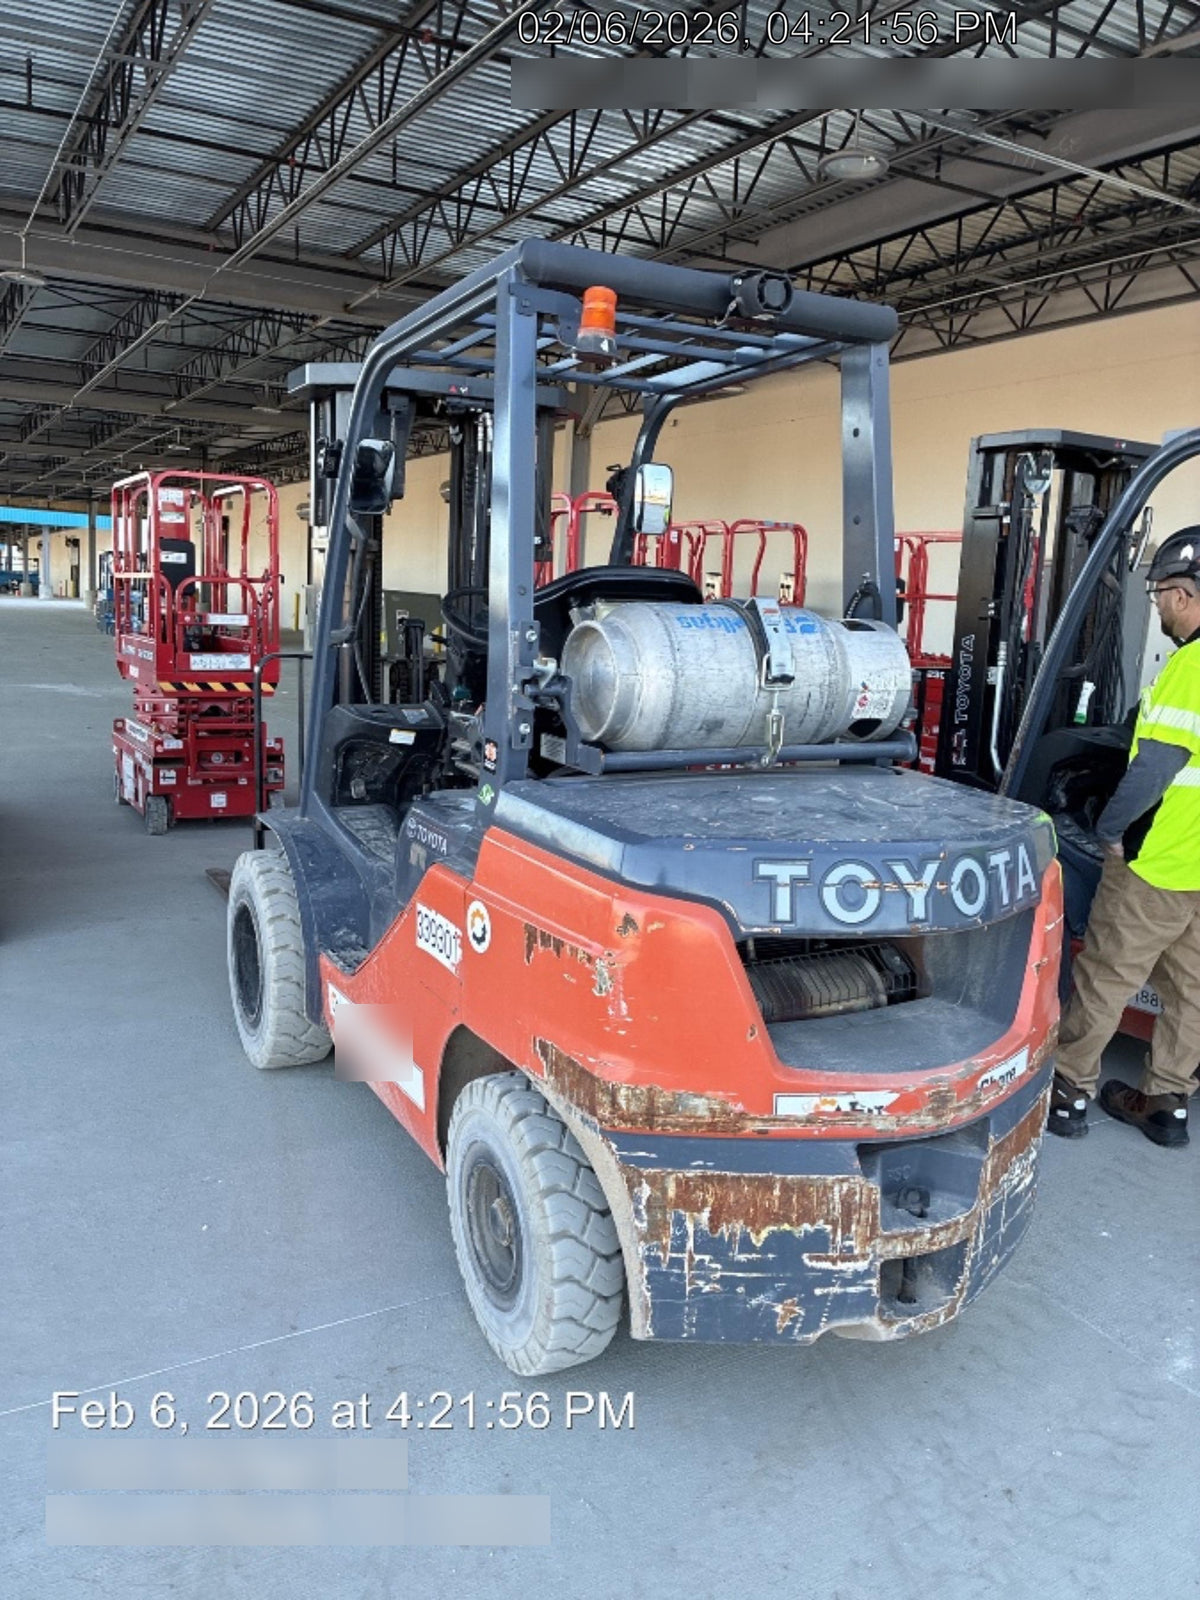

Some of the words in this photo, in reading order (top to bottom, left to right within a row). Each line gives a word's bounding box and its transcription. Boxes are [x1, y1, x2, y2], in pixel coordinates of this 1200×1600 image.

[954, 634, 975, 724] TOYOTA
[416, 824, 448, 857] TOYOTA
[754, 842, 1038, 924] TOYOTA
